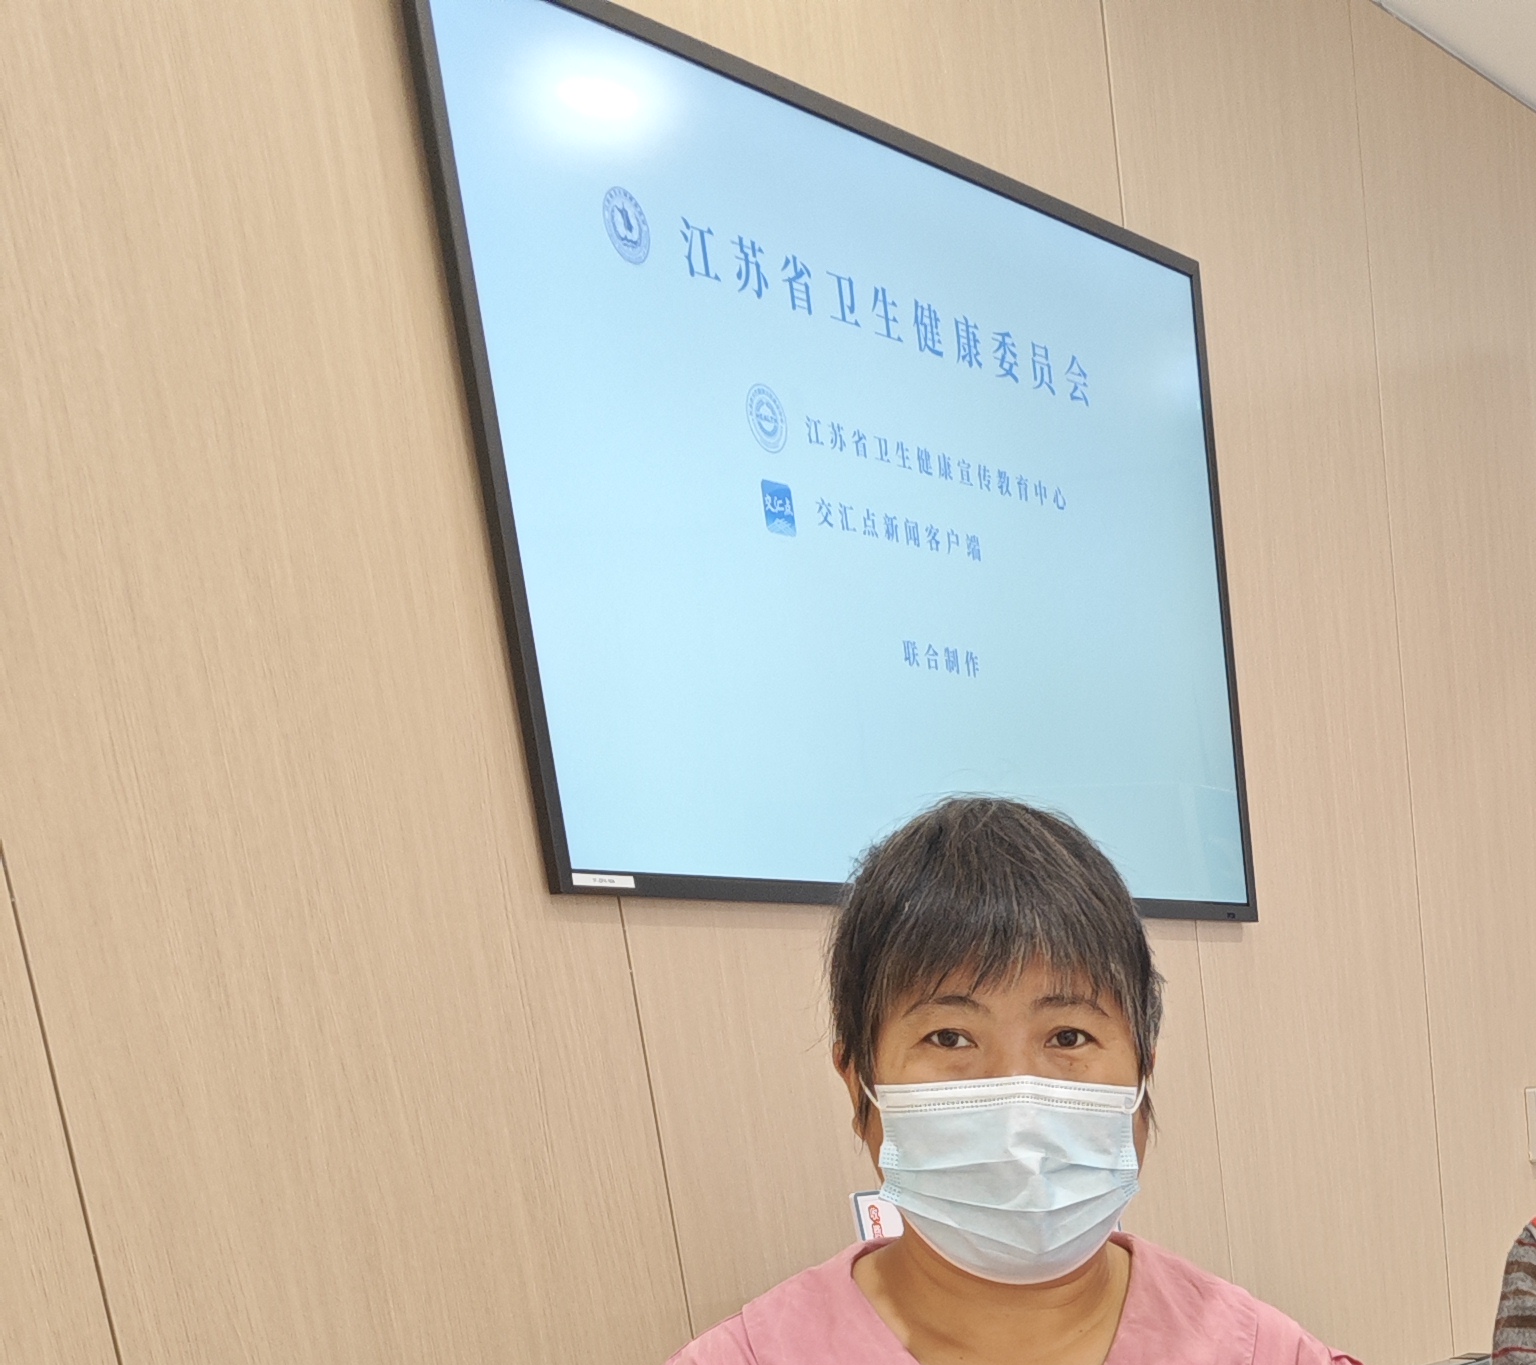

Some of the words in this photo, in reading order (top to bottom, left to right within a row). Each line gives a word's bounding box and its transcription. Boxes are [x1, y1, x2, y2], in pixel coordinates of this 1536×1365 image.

[680, 216, 1090, 407] 江苏省卫生健康委员会
[805, 414, 1067, 511] 江苏省卫生健康宣传教育中心
[815, 497, 982, 562] 交汇点新闻客户端
[902, 639, 980, 678] 联合制作
